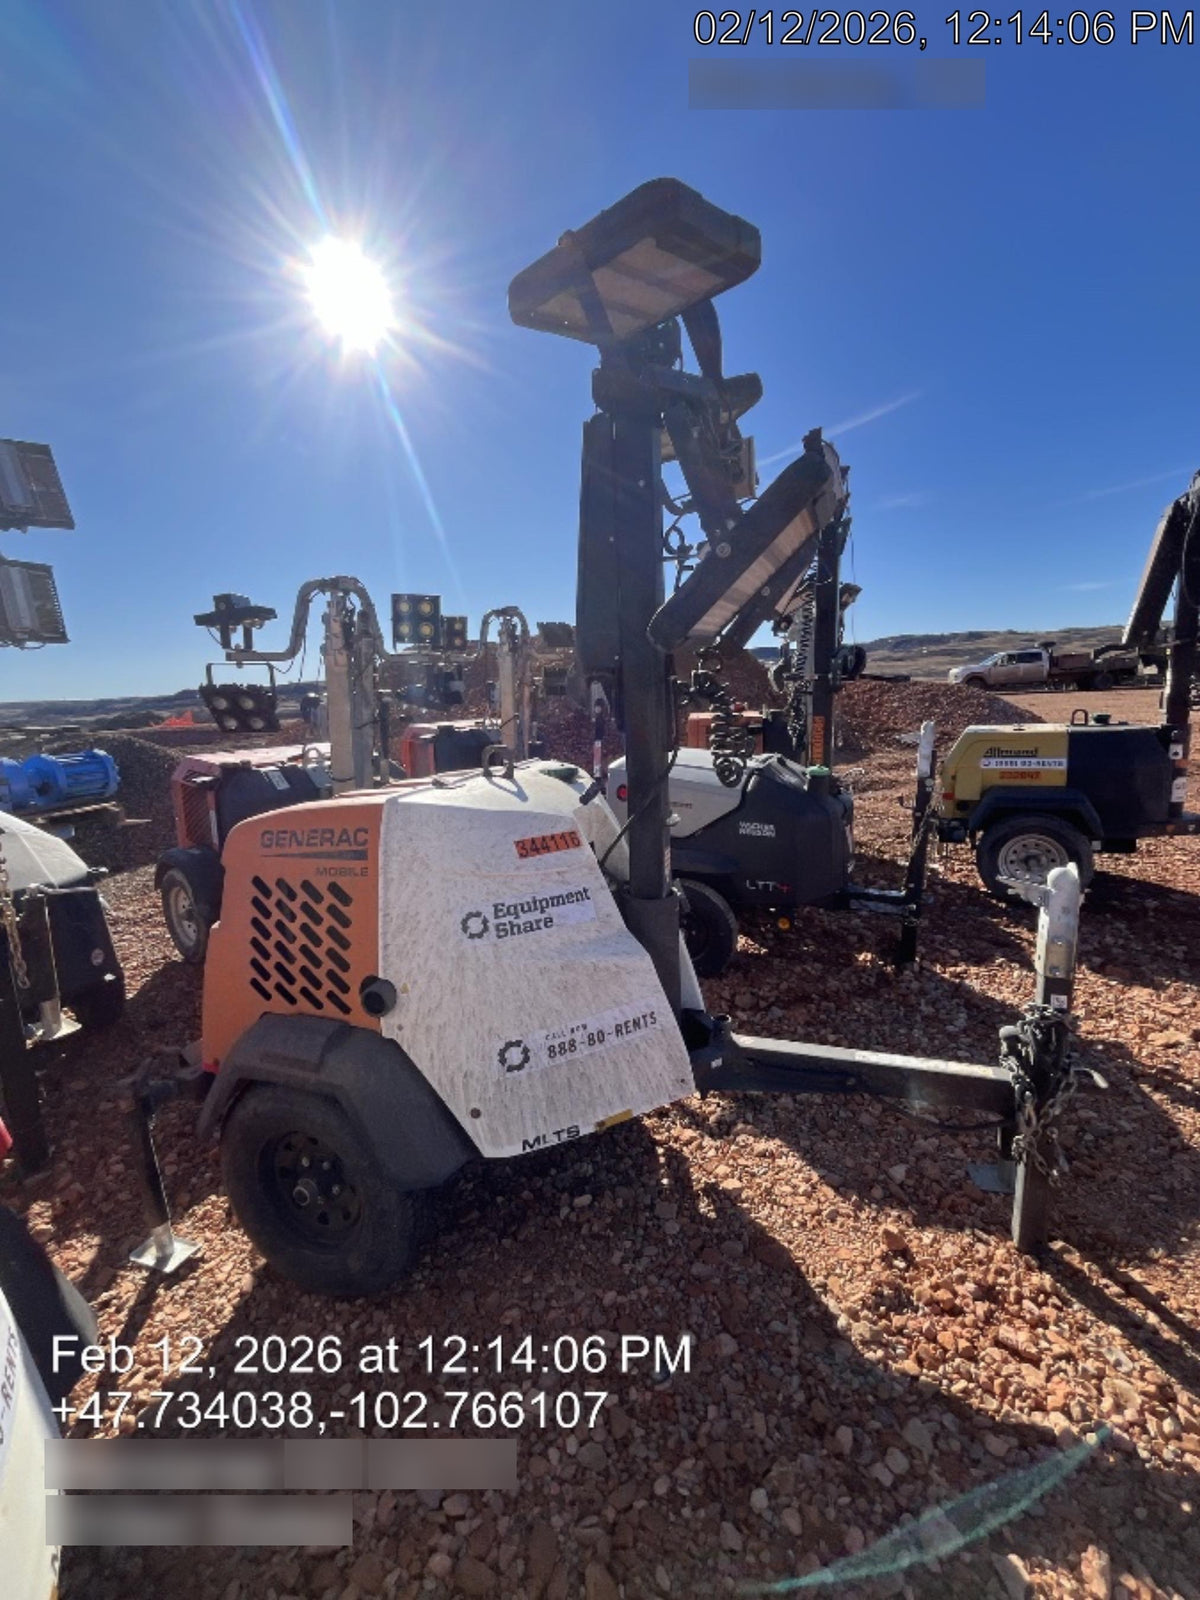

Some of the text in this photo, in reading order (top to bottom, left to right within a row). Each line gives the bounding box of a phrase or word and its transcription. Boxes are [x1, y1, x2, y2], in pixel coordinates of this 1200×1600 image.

[260, 828, 369, 849] GENERAC
[515, 831, 581, 859] 344116
[315, 866, 369, 877] MOBILE
[493, 886, 591, 920] Equipment
[495, 914, 554, 939] Share
[547, 1011, 657, 1059] 888-80-RENTS
[522, 1126, 580, 1151] MLTS
